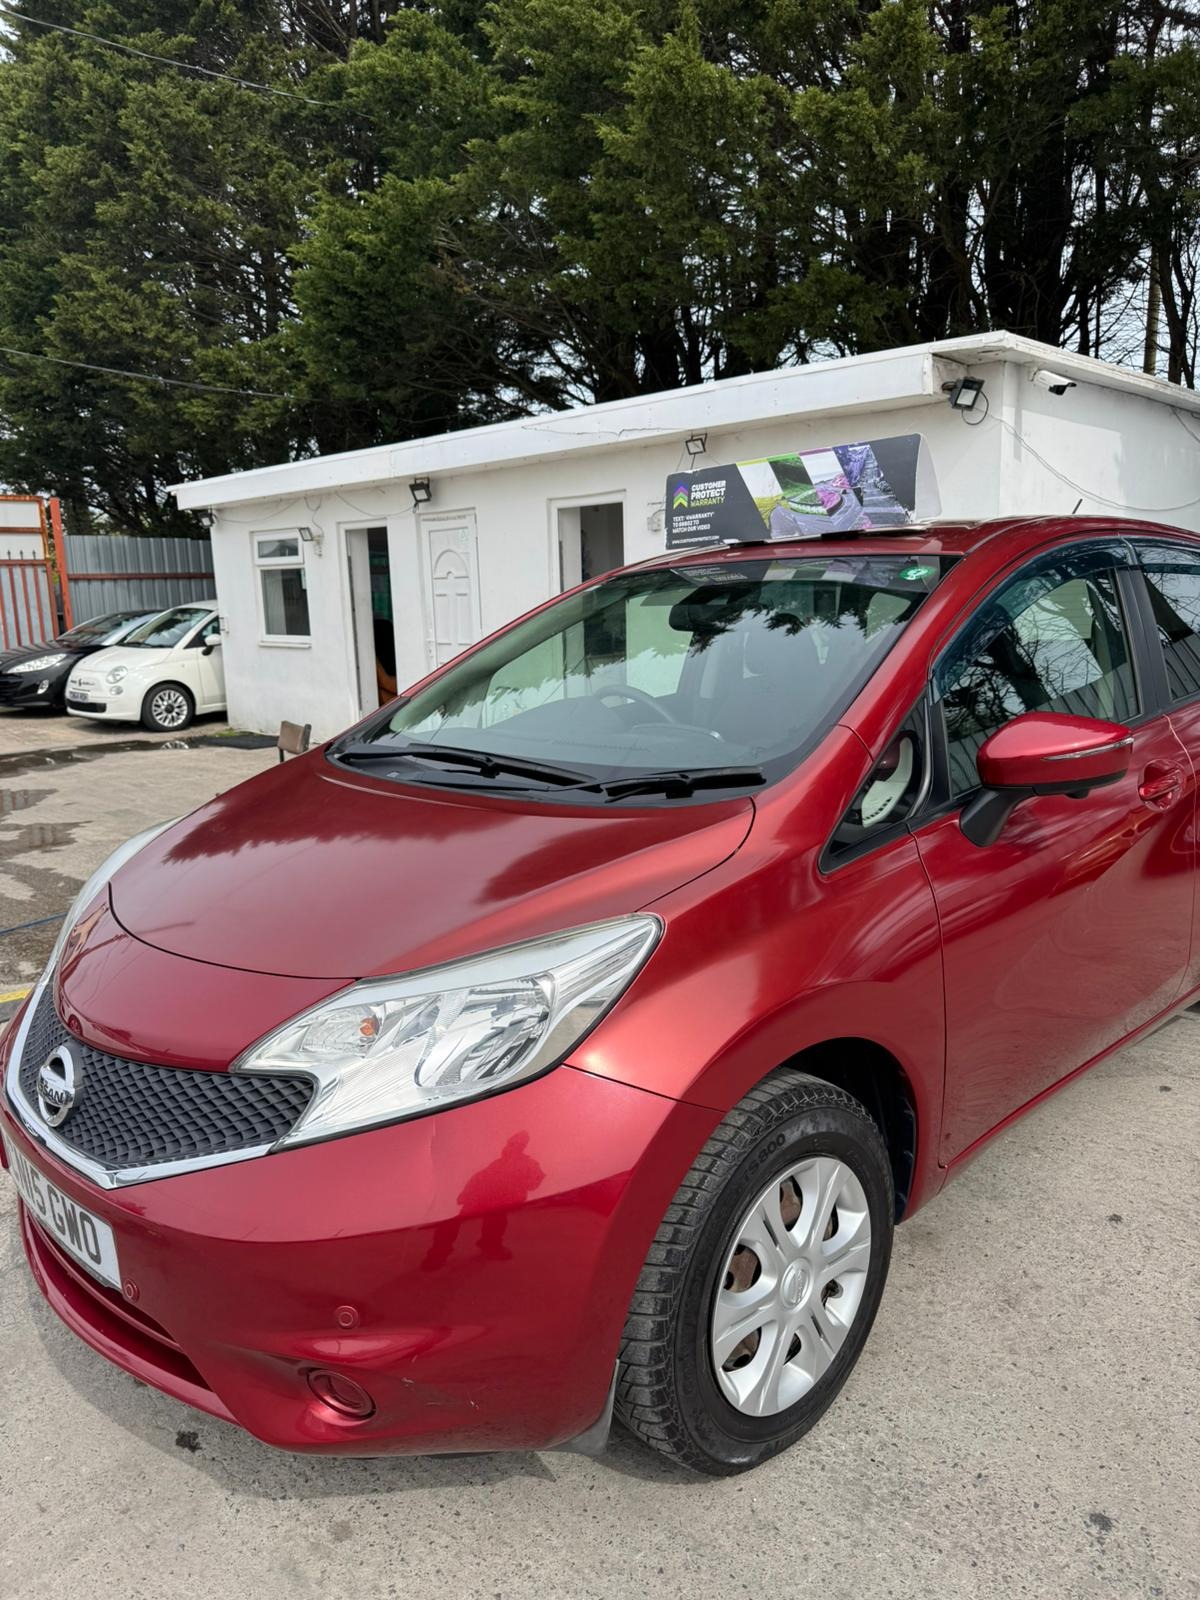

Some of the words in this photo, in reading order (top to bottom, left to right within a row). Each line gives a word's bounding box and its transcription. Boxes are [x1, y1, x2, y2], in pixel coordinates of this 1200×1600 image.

[691, 480, 726, 491] CUSTOMER
[691, 488, 725, 500] PROTECT
[691, 497, 725, 507] WARRANTY
[47, 1184, 101, 1264] GWO
